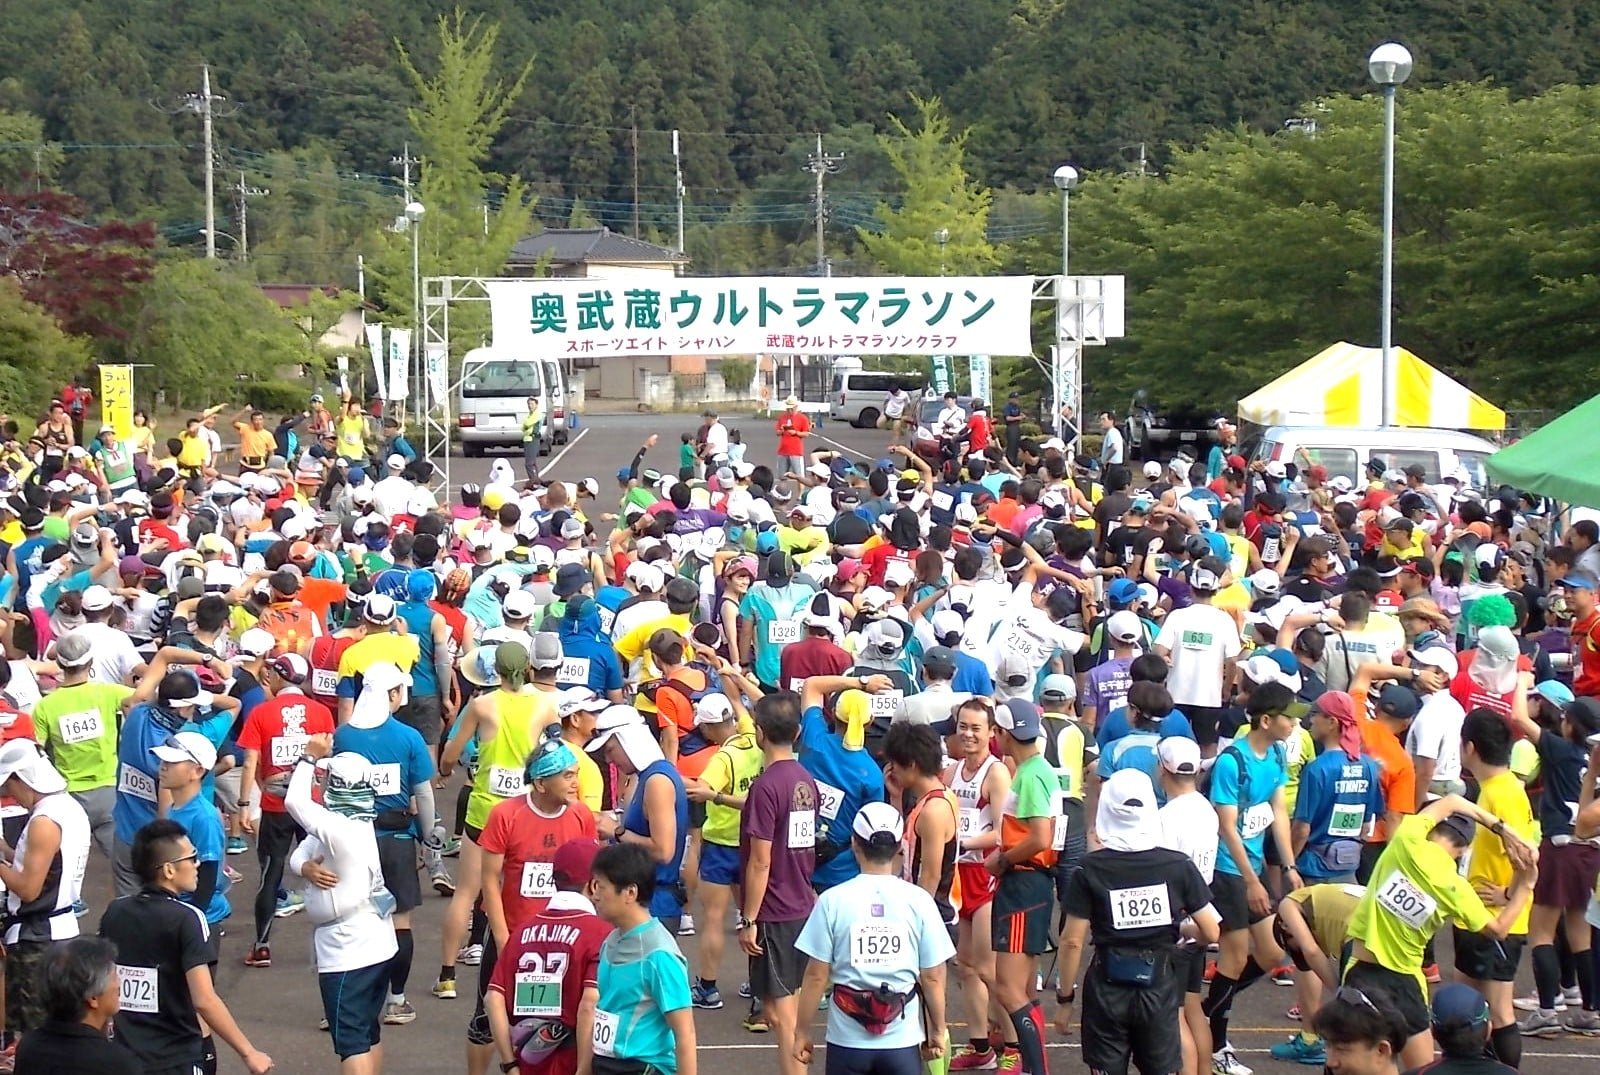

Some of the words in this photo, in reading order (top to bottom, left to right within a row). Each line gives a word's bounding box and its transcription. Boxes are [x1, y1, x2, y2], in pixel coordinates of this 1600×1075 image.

[530, 286, 995, 335] 奥武蔵ウルトラマラソン
[772, 626, 796, 638] 1328
[1191, 632, 1204, 644] 63
[1007, 632, 1032, 654] 2138
[318, 676, 337, 689] 769
[870, 697, 898, 710] 1558
[65, 717, 98, 736] 1643
[276, 743, 308, 758] 2125
[124, 772, 153, 794] 1053
[497, 774, 521, 790] 763
[1341, 813, 1357, 828] 85
[528, 872, 554, 888] 164
[1117, 896, 1162, 918] 1826
[1386, 882, 1427, 917] 1807
[521, 924, 581, 946] OKAJIMA
[857, 935, 901, 955] 1529
[530, 985, 546, 1004] 17
